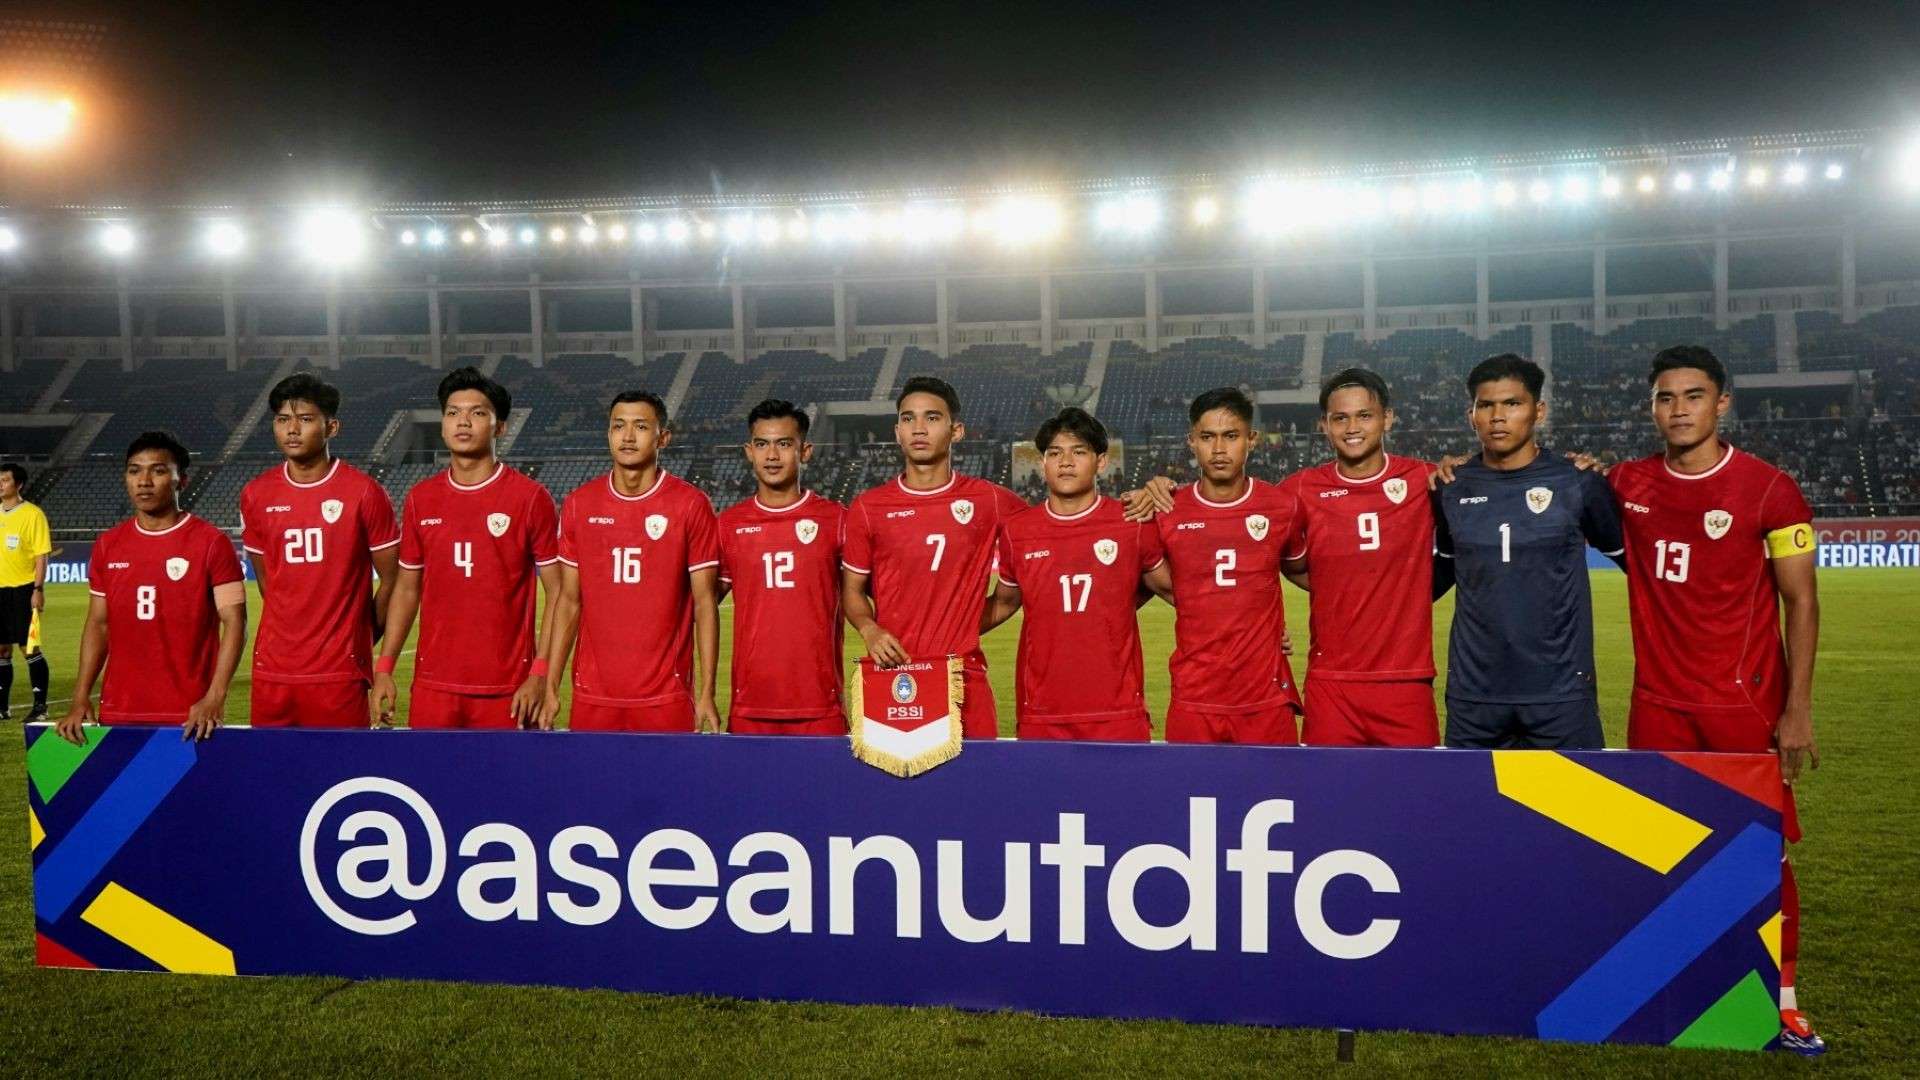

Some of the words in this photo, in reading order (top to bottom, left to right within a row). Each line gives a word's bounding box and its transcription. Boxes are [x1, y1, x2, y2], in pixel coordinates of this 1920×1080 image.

[1319, 489, 1349, 499] erspo
[1459, 496, 1489, 506] erspo
[285, 527, 323, 563] 20
[1177, 522, 1206, 532] erspo
[1357, 512, 1381, 551] 9
[1498, 522, 1511, 562] 1
[1794, 529, 1808, 548] C
[1840, 529, 1887, 544] CUP
[454, 541, 474, 578] 4
[611, 547, 642, 584] 16
[762, 551, 795, 589] 12
[926, 534, 946, 572] 7
[1215, 548, 1237, 587] 2
[1654, 539, 1691, 583] 13
[1818, 544, 1920, 567] FEDERATI
[136, 585, 157, 621] 8
[1059, 573, 1093, 612] 17
[887, 705, 924, 718] PSSI
[299, 776, 1401, 960] @aseanutdfc
